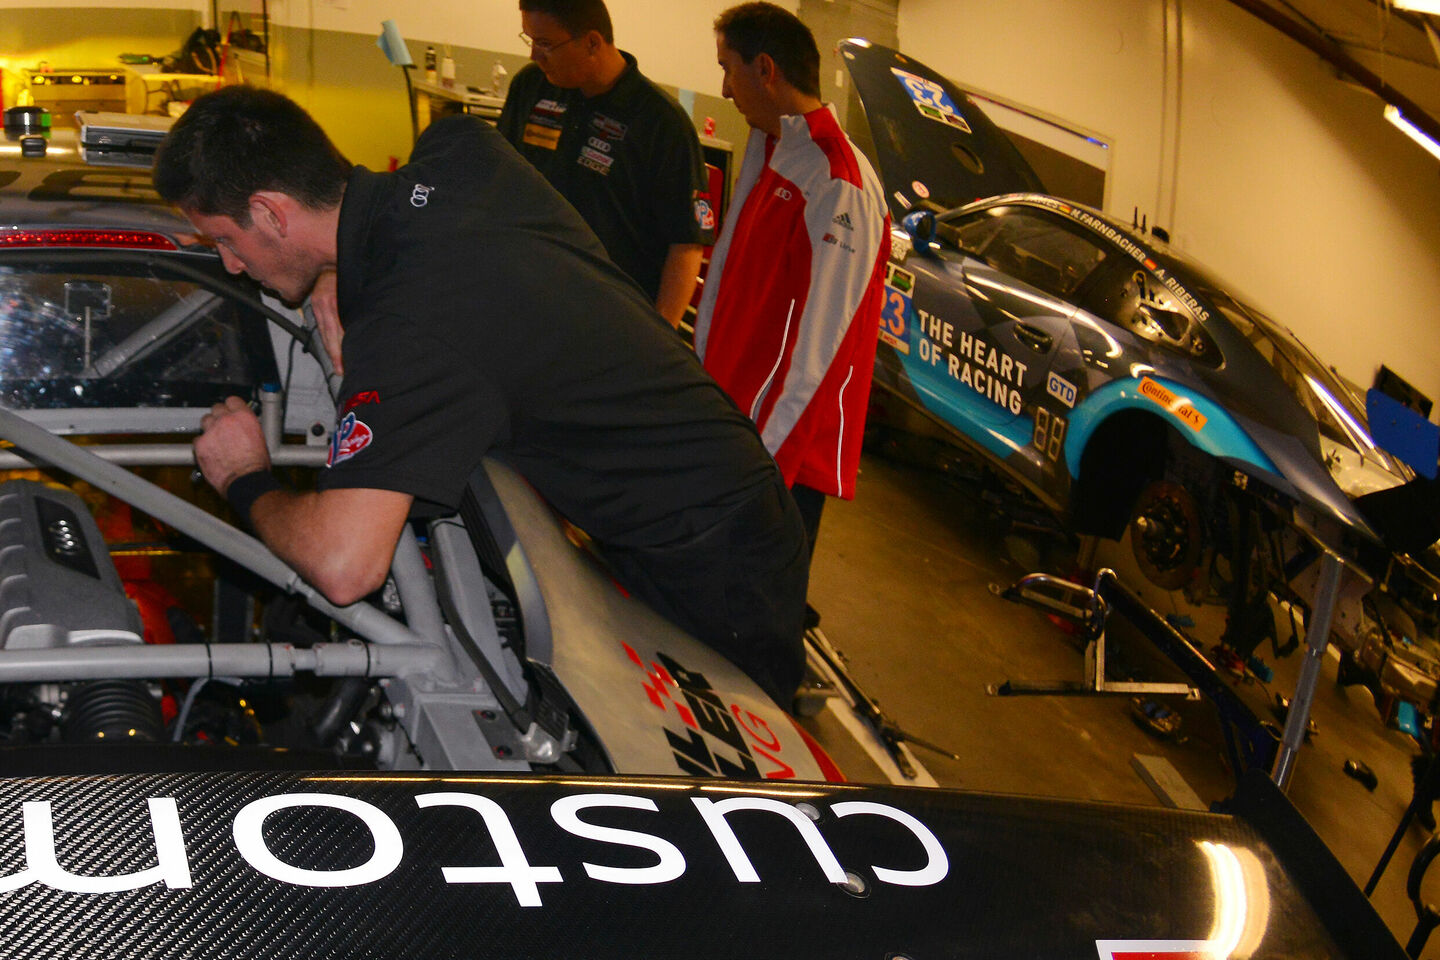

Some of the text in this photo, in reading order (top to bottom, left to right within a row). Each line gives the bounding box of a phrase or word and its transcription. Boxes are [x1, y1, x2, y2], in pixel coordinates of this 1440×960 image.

[904, 78, 953, 115] 23
[1165, 276, 1211, 322] RIBERAS
[918, 309, 1028, 387] THE HEART
[919, 338, 1023, 416] OF RACING
[1048, 376, 1075, 403] GTD
